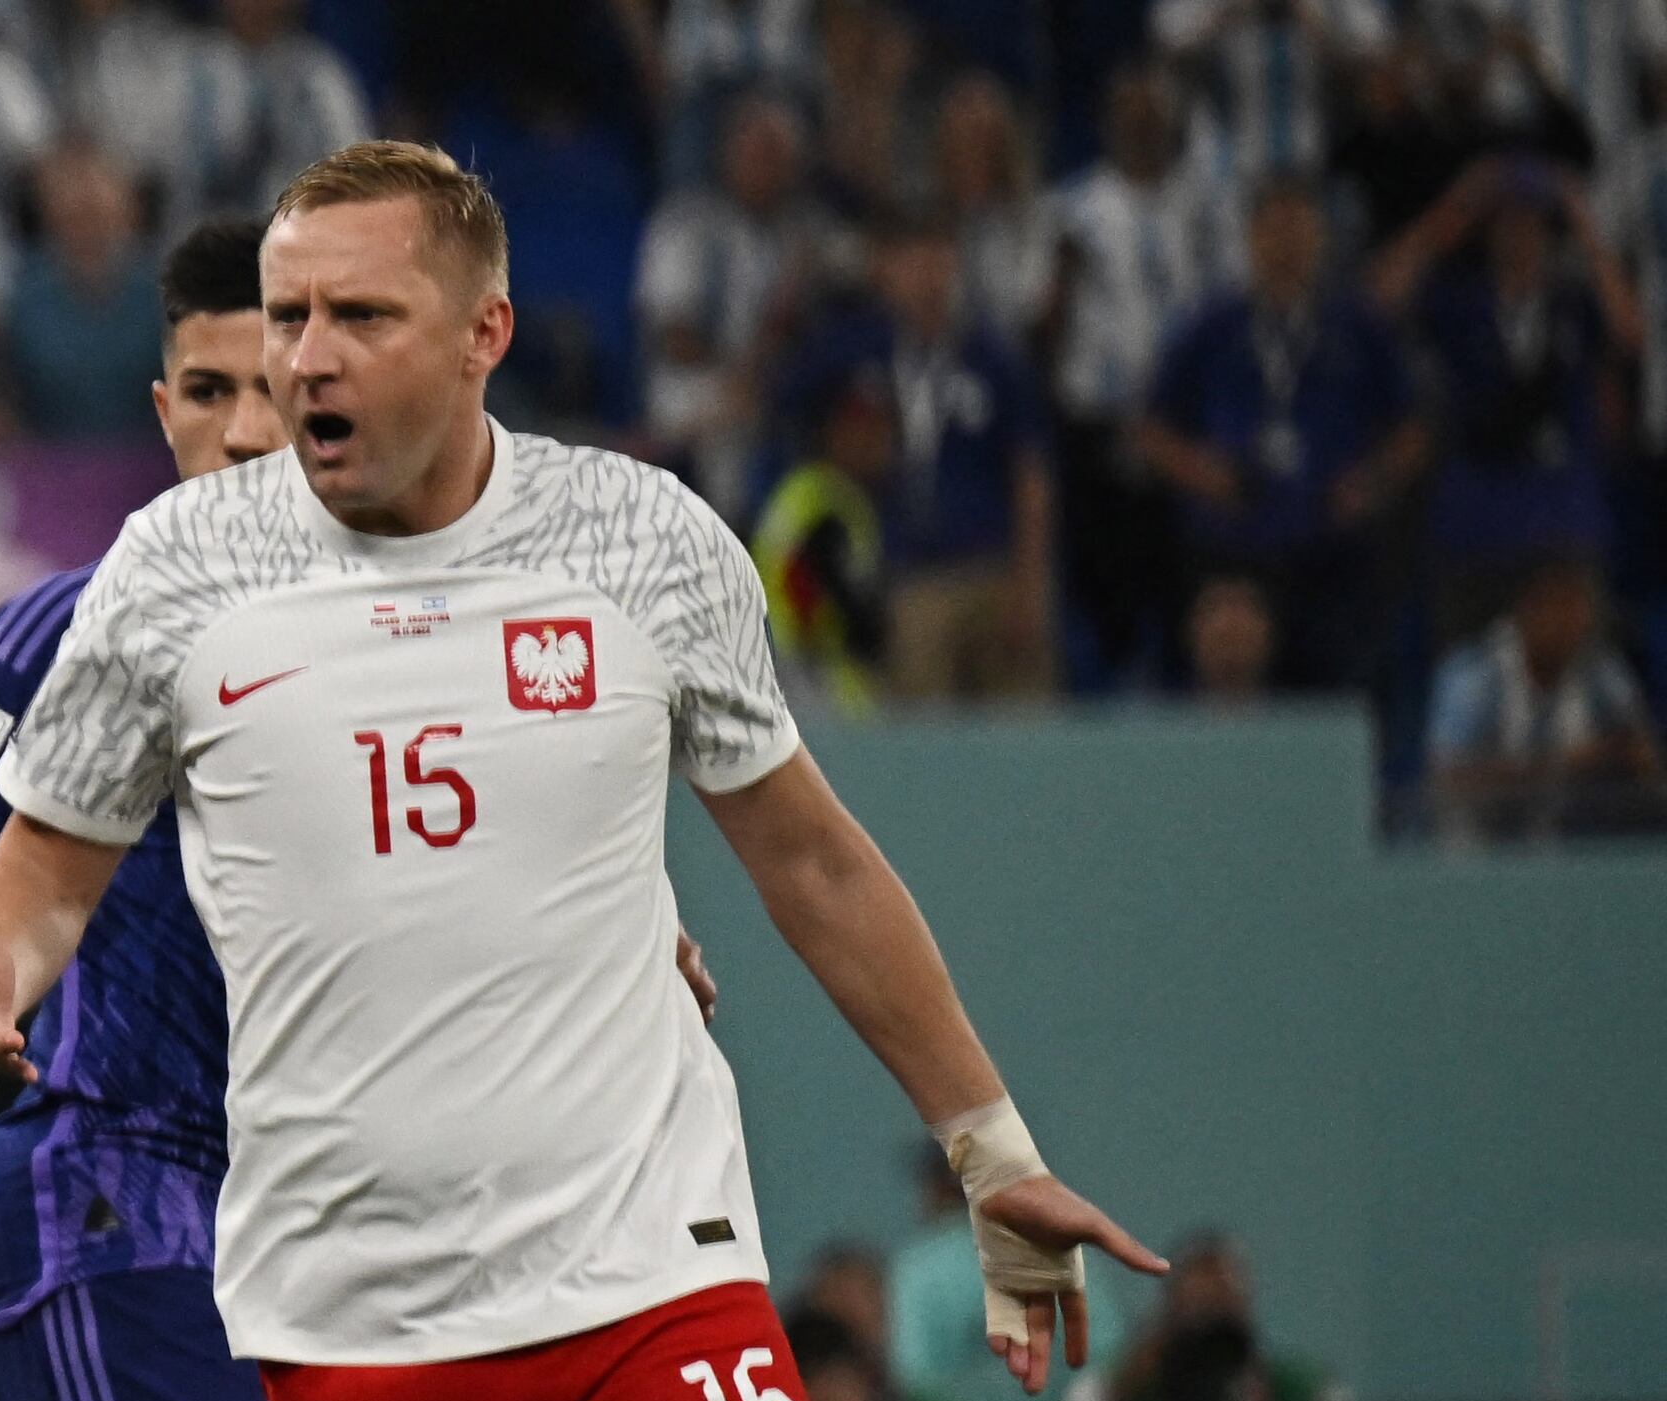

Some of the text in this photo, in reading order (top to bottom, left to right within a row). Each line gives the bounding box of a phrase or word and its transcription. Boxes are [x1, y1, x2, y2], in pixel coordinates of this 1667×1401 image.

[370, 612, 450, 626] POLAND ARGENTINA
[354, 723, 476, 855] 15
